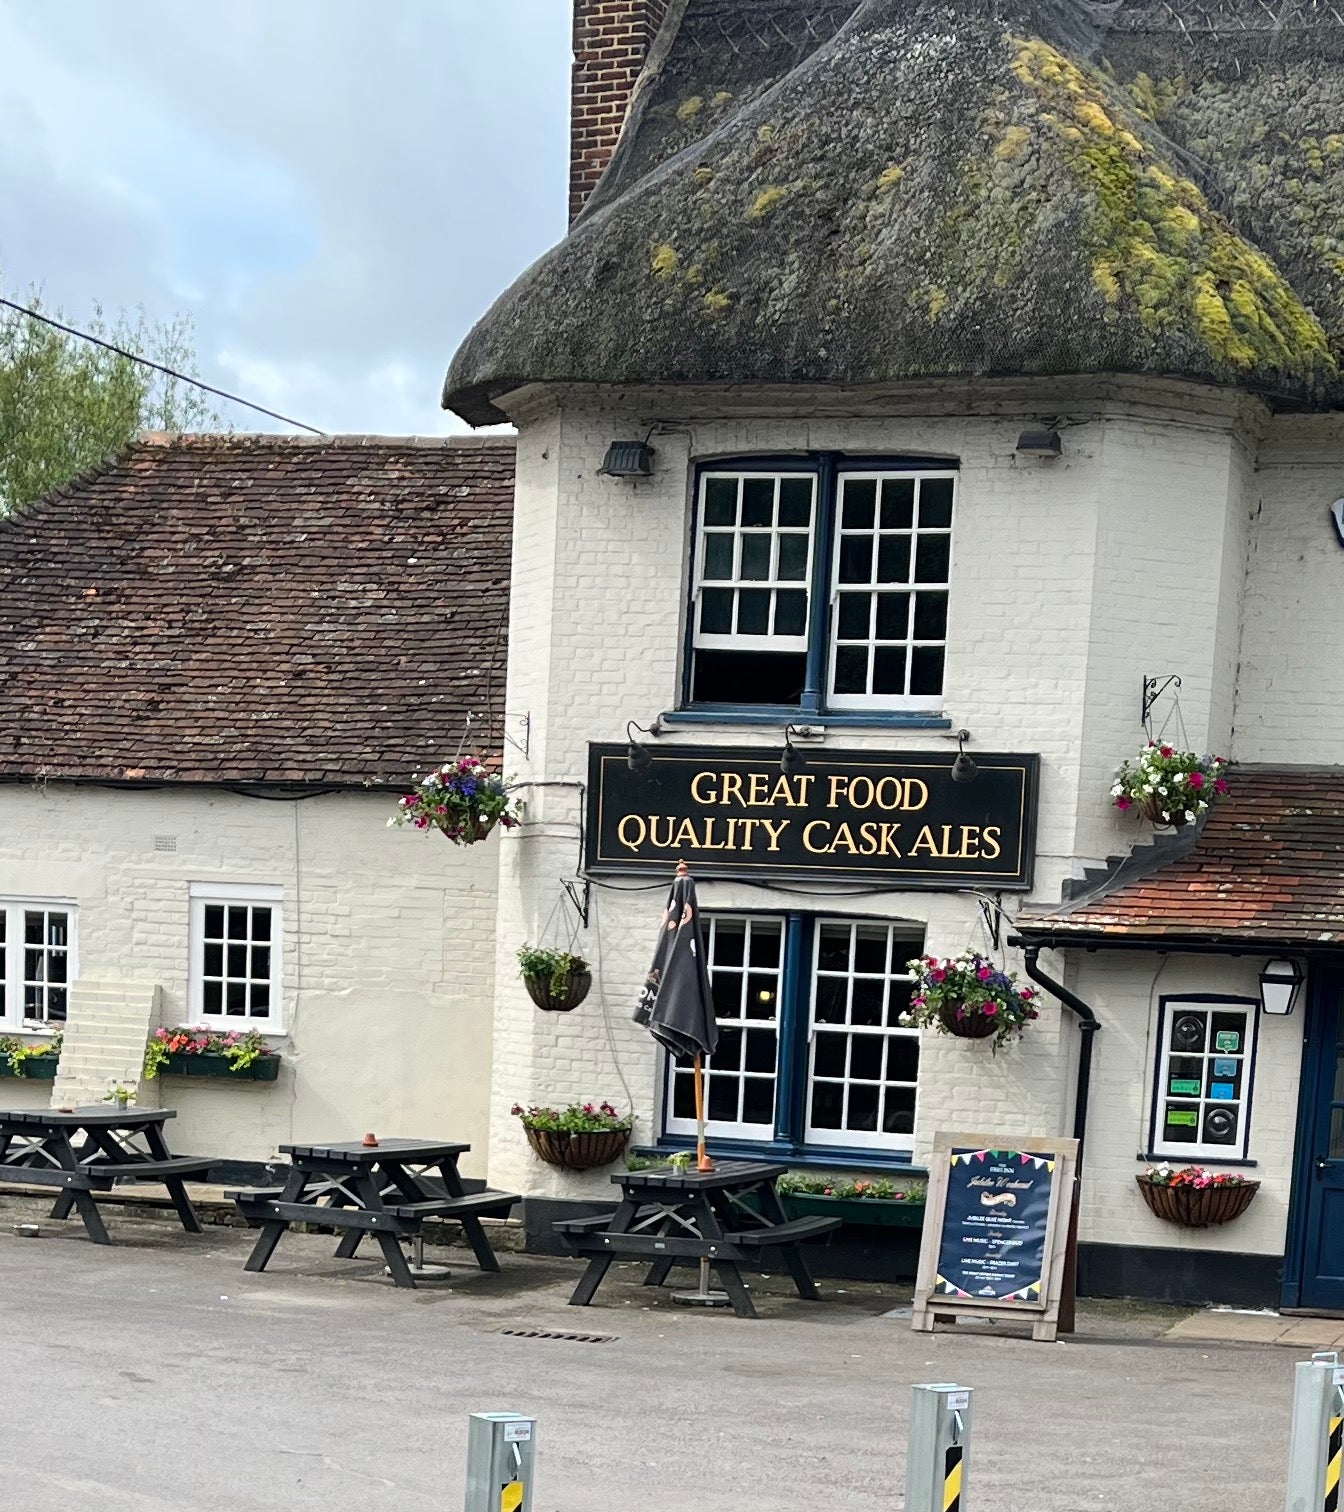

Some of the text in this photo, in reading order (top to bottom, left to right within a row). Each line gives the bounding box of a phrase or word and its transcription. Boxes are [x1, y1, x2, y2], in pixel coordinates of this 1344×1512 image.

[690, 771, 929, 811] GREAT FOOD
[617, 814, 1002, 860] QUALITY CASK ALES
